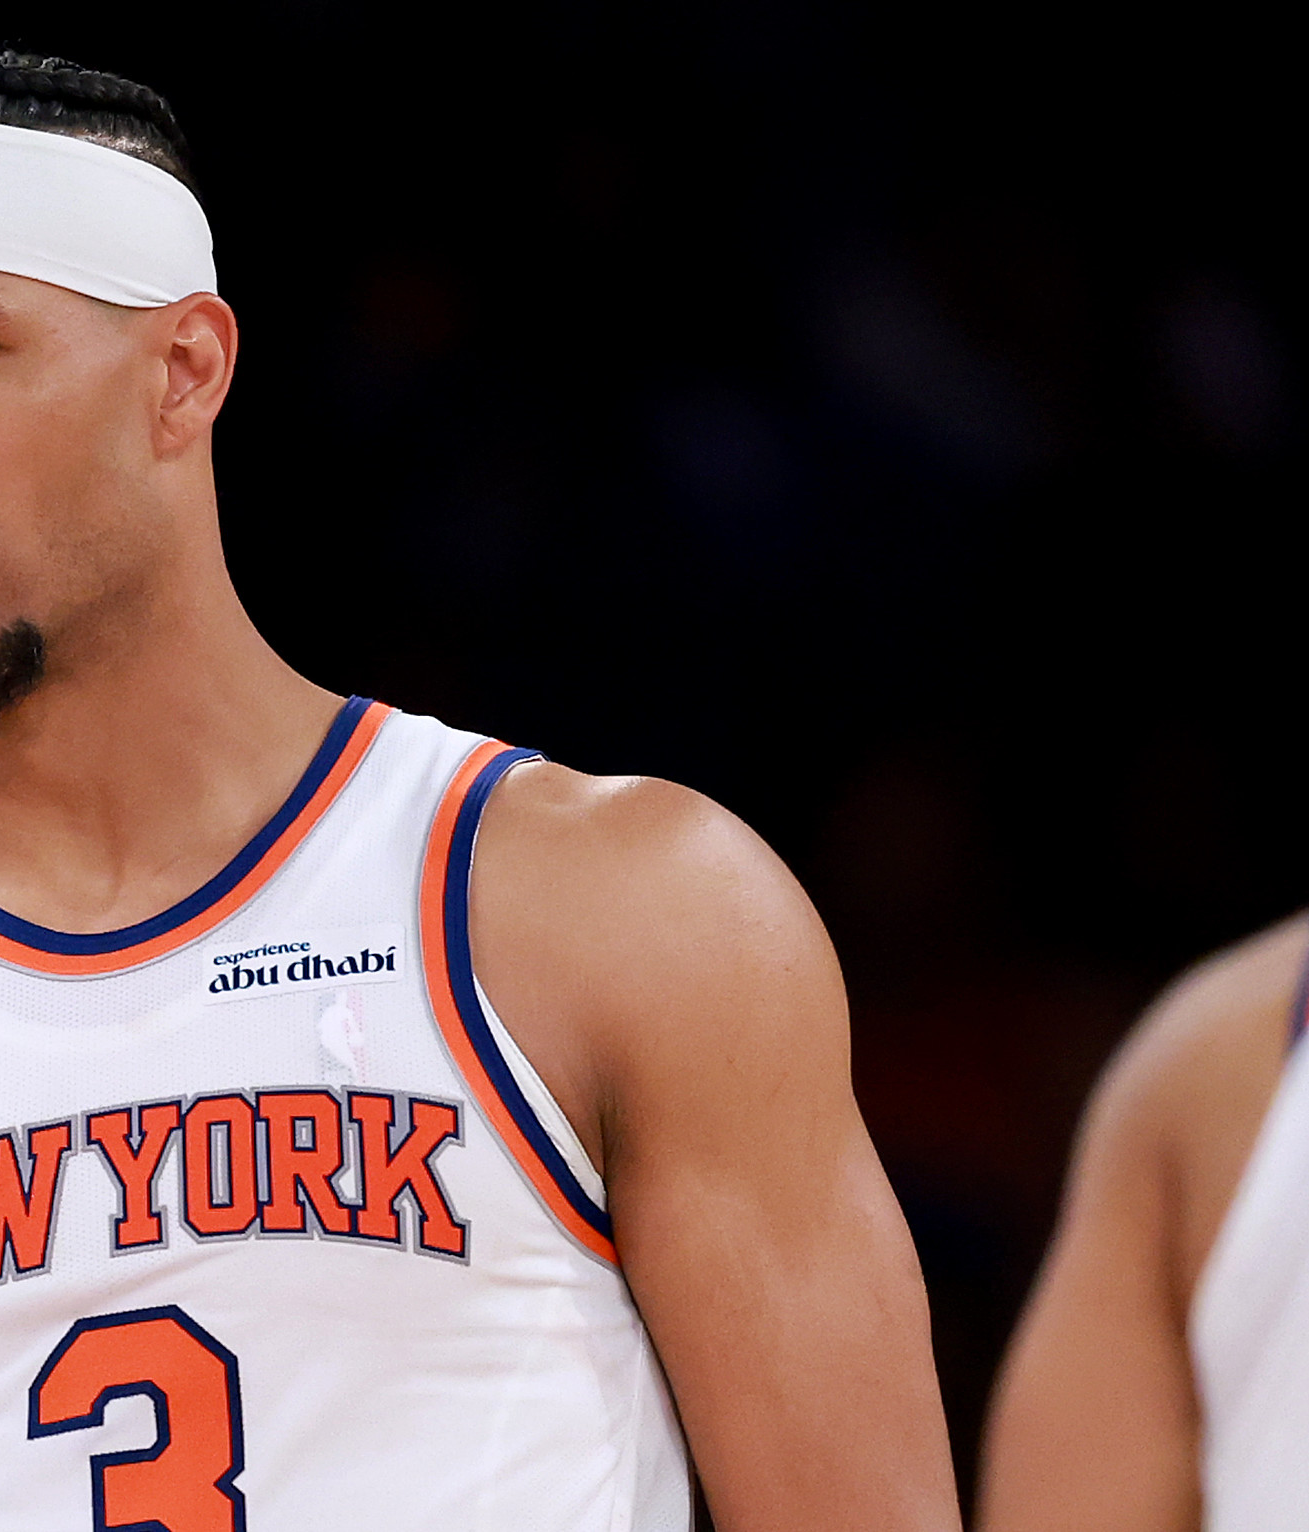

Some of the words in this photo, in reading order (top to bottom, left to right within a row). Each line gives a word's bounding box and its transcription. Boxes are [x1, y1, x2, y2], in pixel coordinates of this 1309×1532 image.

[208, 965, 279, 994] abu
[82, 1085, 471, 1266] YORK
[27, 1304, 247, 1532] 3
